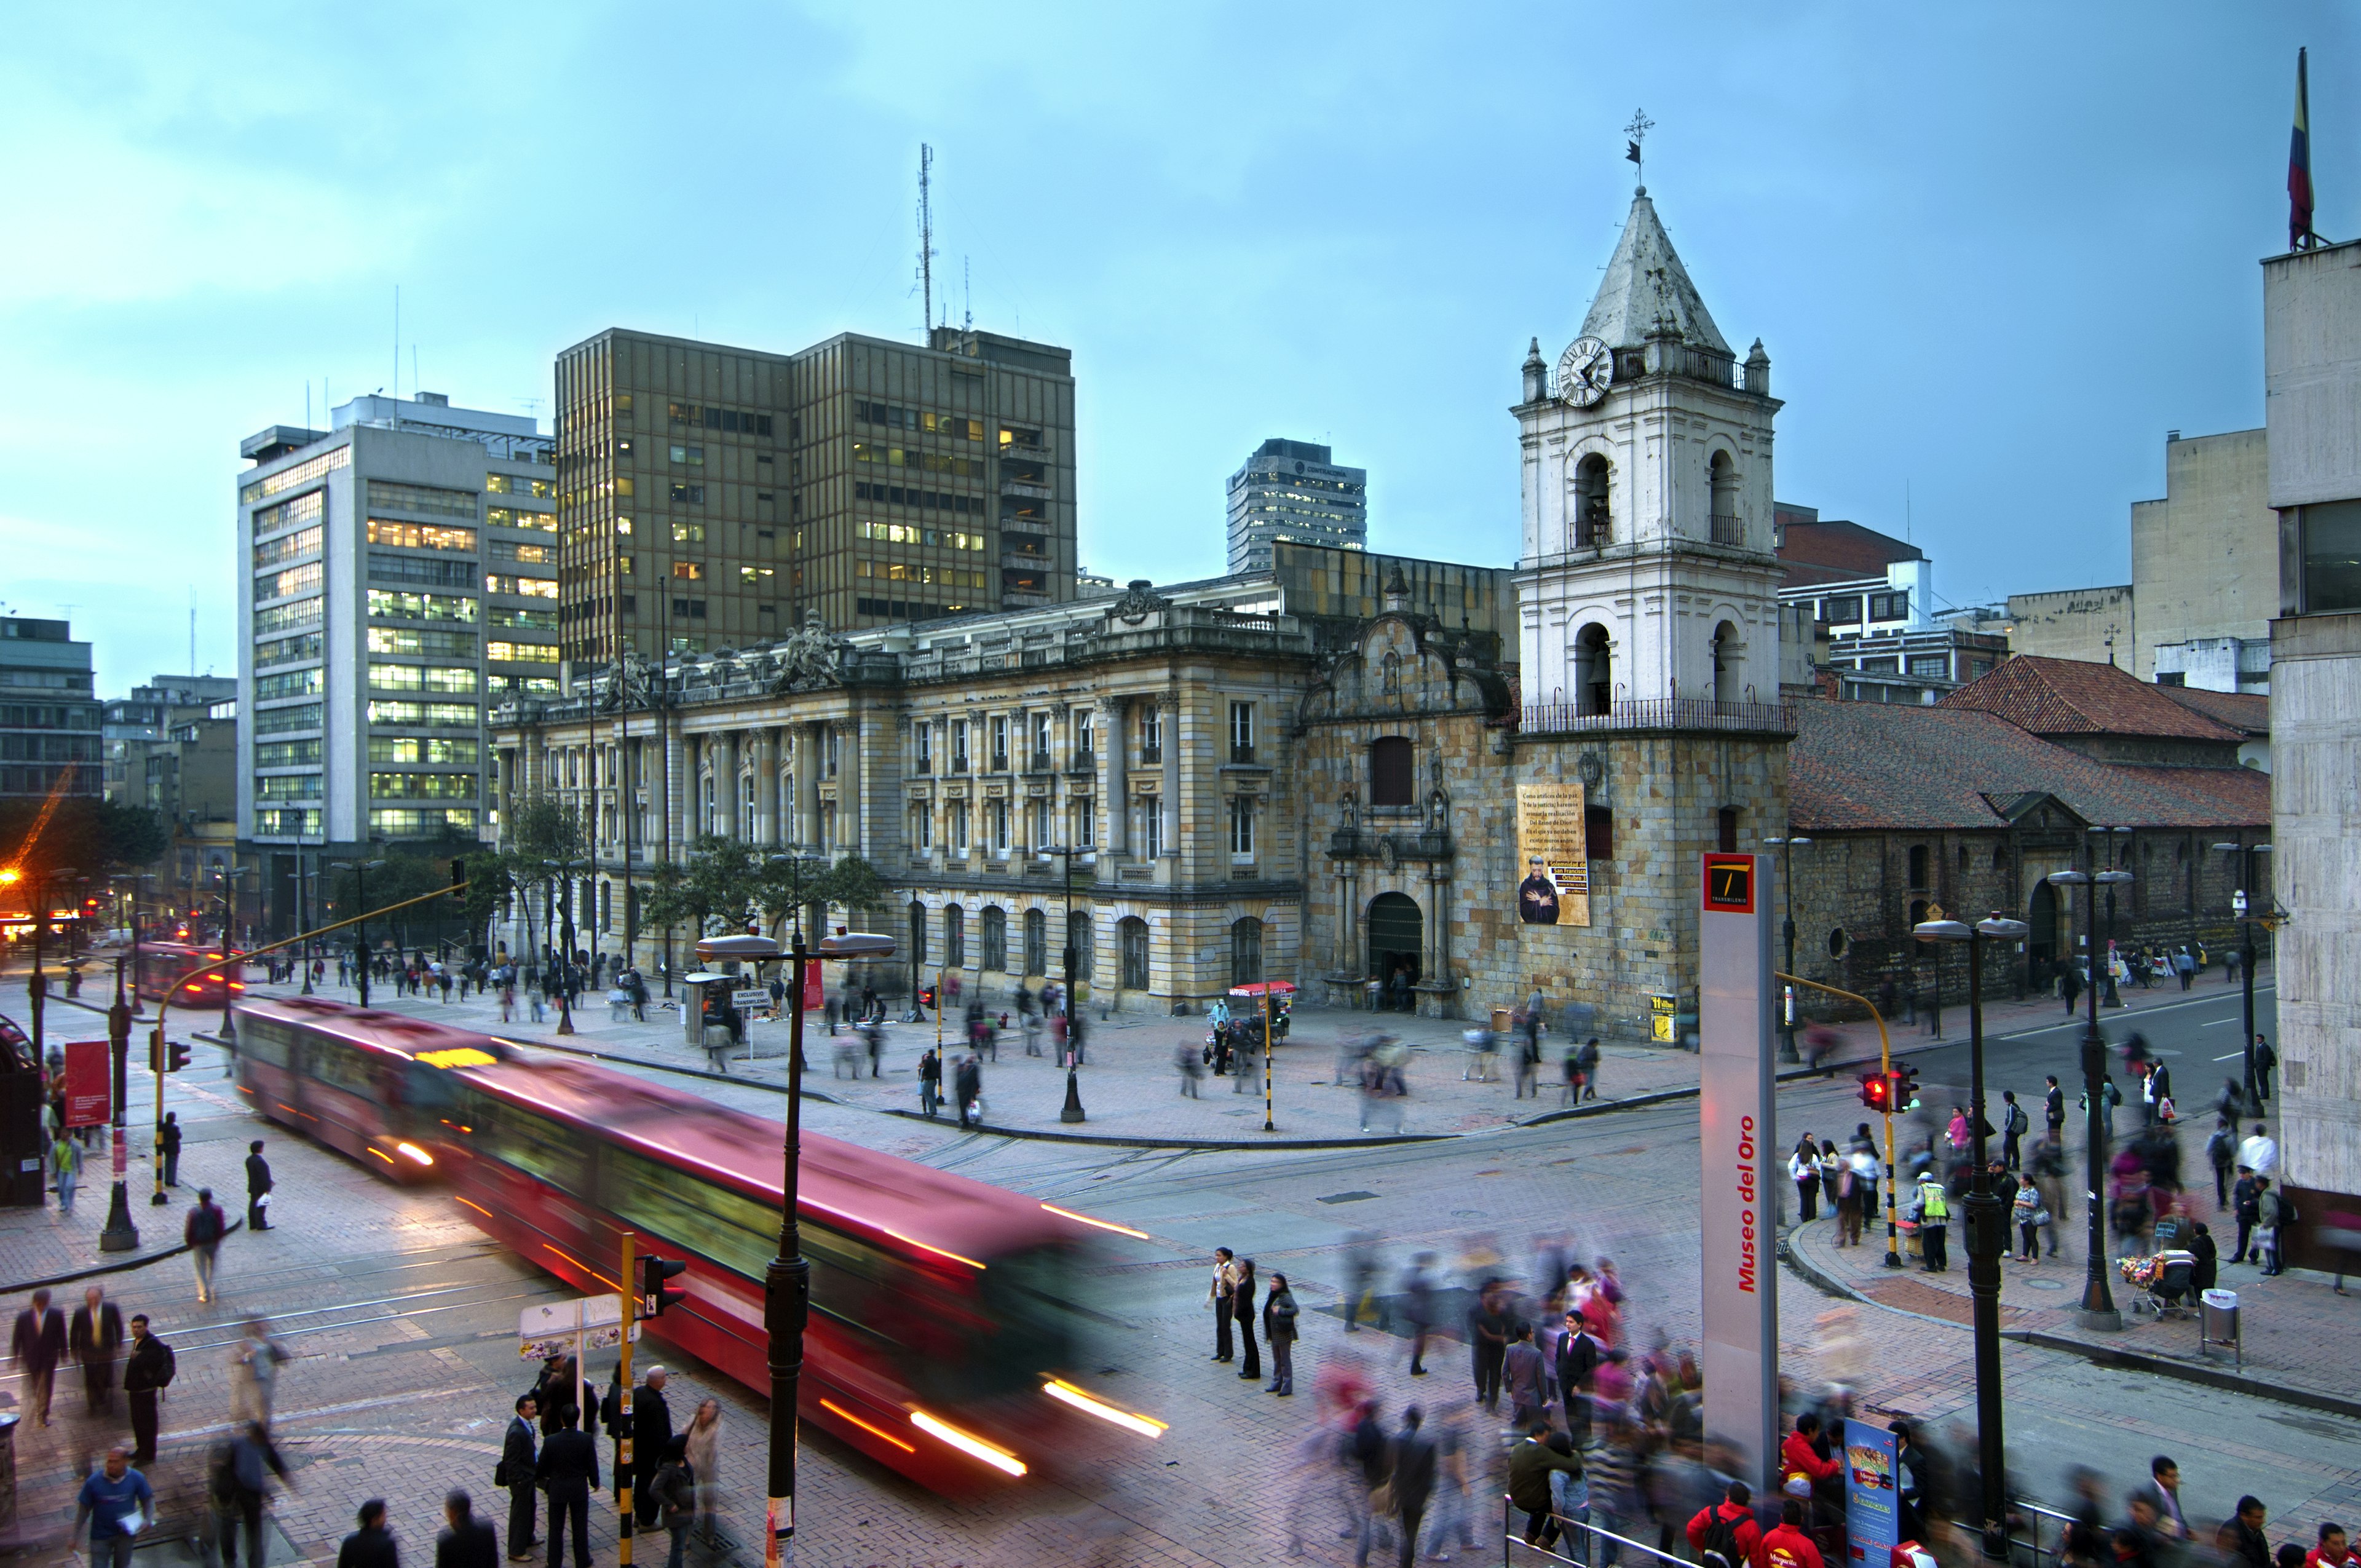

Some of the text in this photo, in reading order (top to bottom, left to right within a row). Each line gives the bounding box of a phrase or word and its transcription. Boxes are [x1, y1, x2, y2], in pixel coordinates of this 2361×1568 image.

[1737, 1115, 1754, 1293] Museo del Oro
[1859, 1499, 1891, 1514] EMPAQUES
[1853, 1534, 1872, 1545] PASAJE
[1770, 1553, 1797, 1566] Margarita
